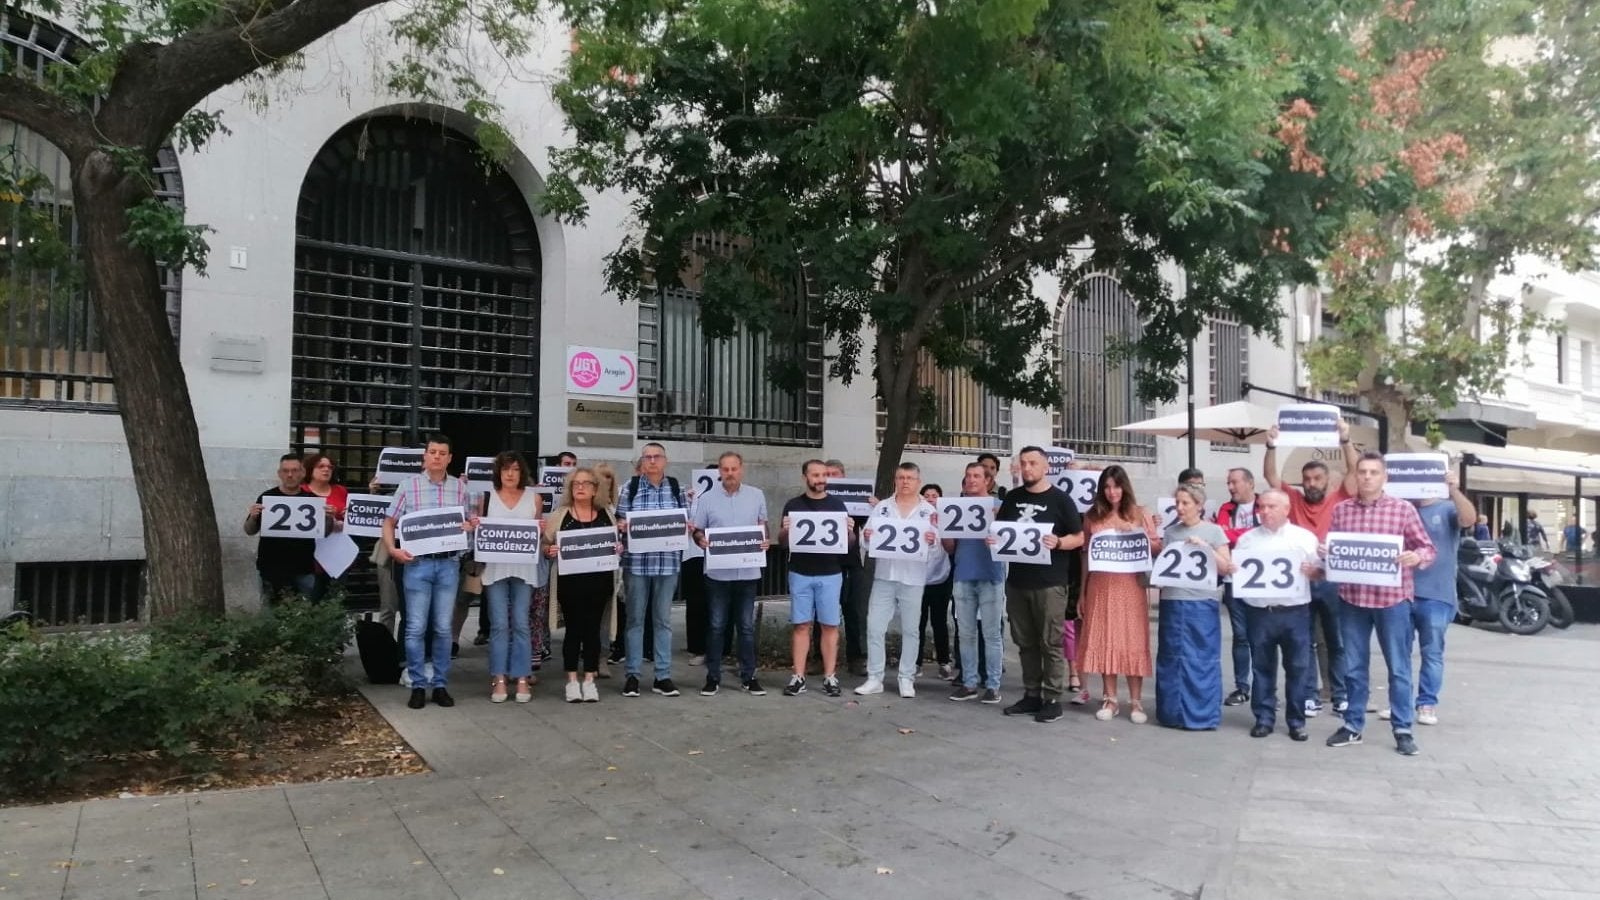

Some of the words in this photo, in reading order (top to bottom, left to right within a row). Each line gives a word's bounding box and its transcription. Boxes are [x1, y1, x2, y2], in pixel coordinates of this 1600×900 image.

[574, 357, 596, 371] UGT
[1057, 477, 1097, 506] 23
[351, 504, 385, 515] CONTA
[268, 503, 317, 532] 23
[348, 515, 384, 526] VERGÜE
[943, 504, 987, 532] 23
[480, 529, 537, 540] CONTADOR
[795, 519, 839, 547] 23
[876, 524, 920, 554] 23
[478, 541, 536, 552] VERGÜENZA
[996, 527, 1041, 556] 23
[1094, 537, 1148, 549] CONTADOR
[1092, 550, 1148, 560] VERGÜENZA
[1332, 545, 1398, 559] CONTADOR
[1158, 548, 1208, 581] 23
[1329, 559, 1397, 572] VERGÜENZA
[1241, 557, 1295, 589] 23
